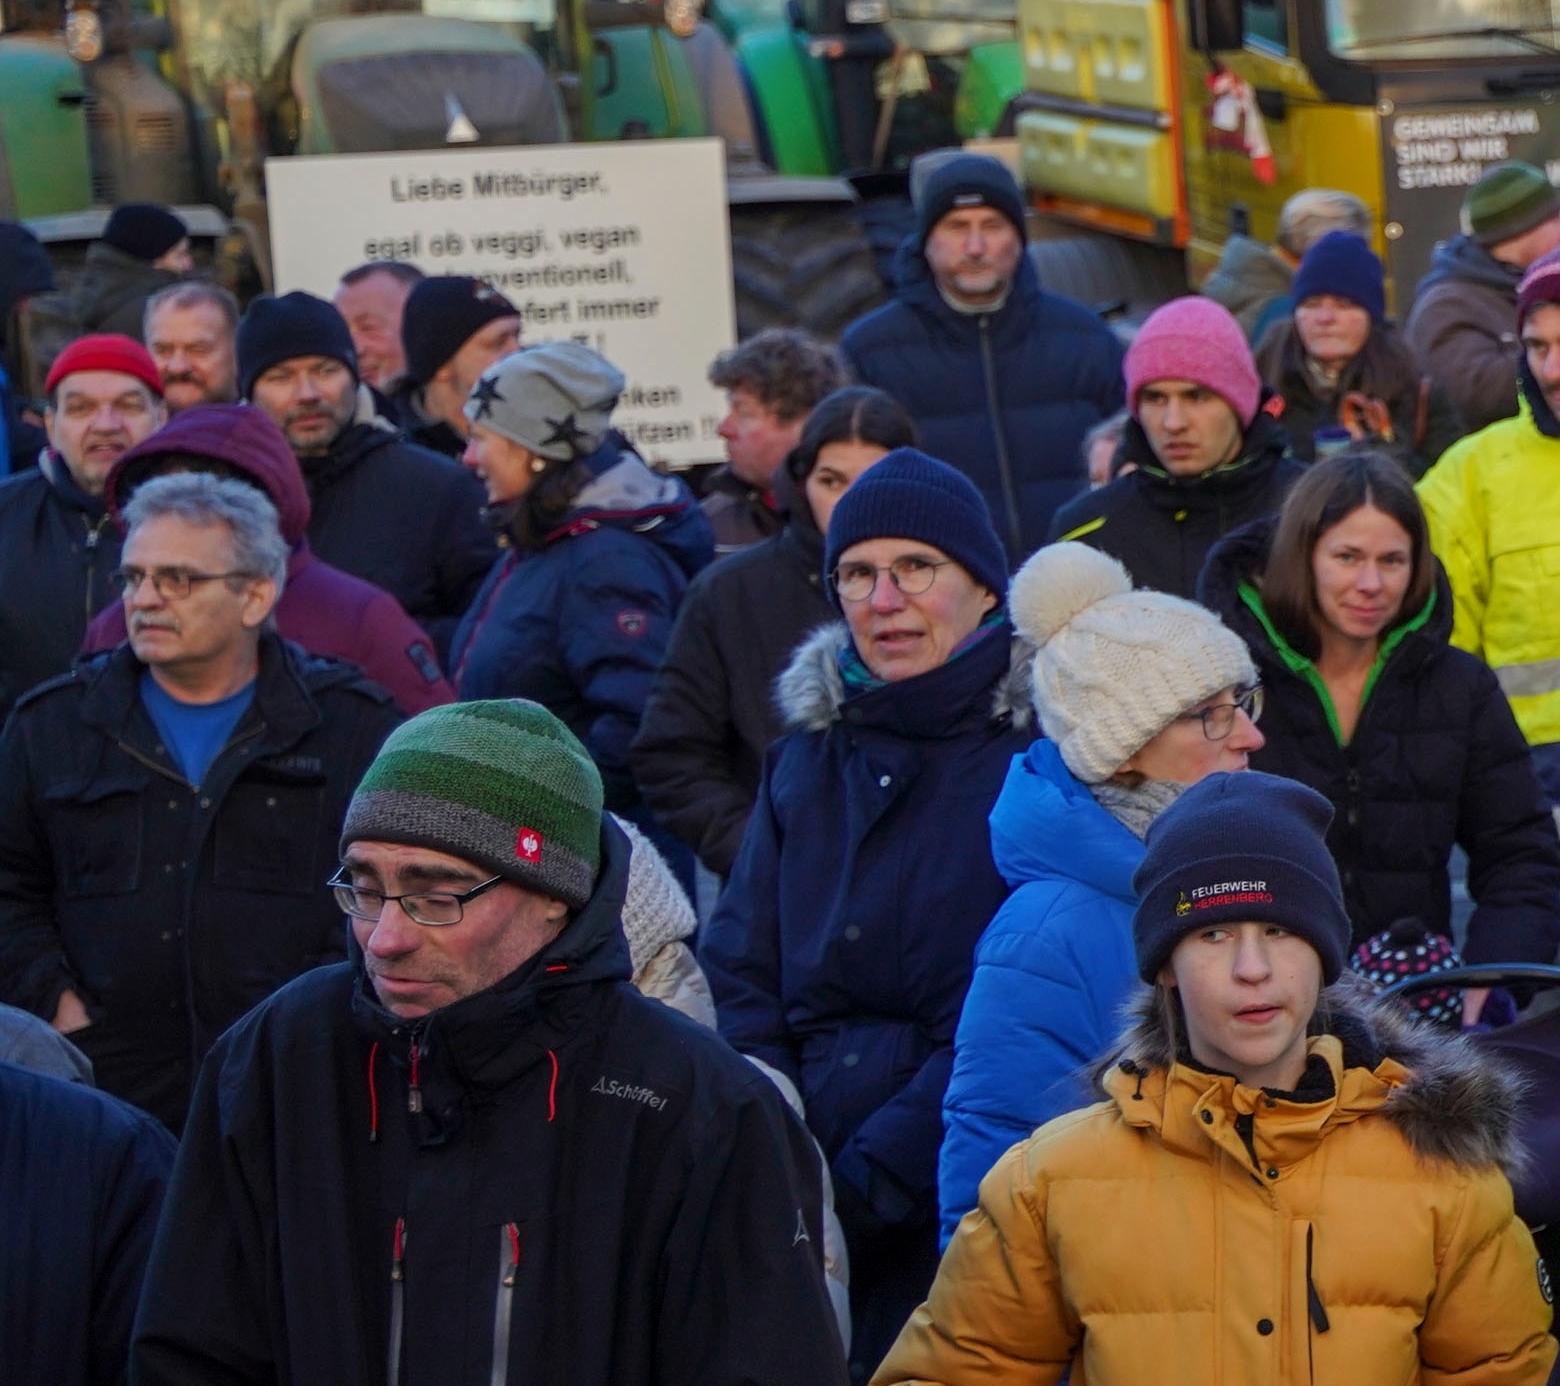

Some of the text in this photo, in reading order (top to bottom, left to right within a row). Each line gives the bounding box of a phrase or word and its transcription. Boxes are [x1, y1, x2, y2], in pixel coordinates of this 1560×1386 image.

[390, 170, 609, 203] Liebe Mitbürger,
[364, 233, 421, 261] egal
[429, 232, 463, 259] ob
[559, 225, 641, 251] vegan
[577, 296, 662, 320] immer
[1191, 880, 1267, 900] FEUERWEHR
[1194, 892, 1274, 910] HERRENBERG
[606, 1079, 668, 1111] Schöffel
